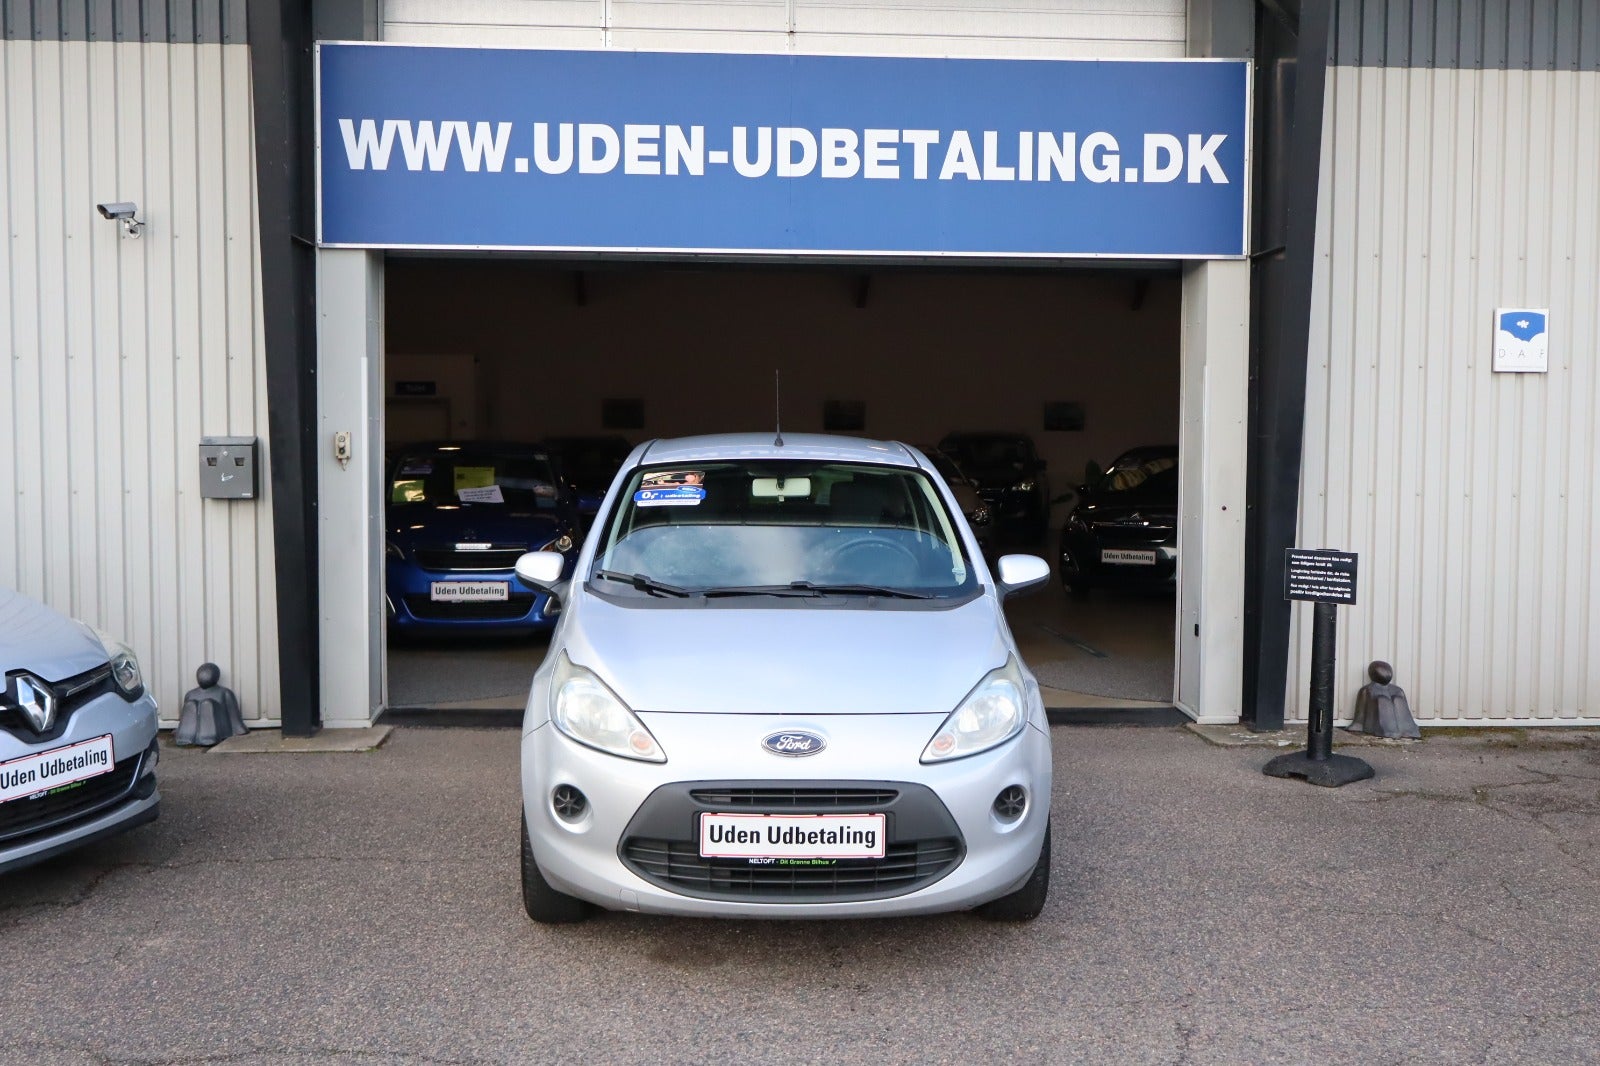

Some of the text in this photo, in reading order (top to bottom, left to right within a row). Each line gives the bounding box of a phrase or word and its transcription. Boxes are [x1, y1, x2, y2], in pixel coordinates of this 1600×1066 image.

[339, 118, 1229, 183] WWW.UDEN-UDBETALING.DK
[435, 587, 504, 597] Uden Udbetaling
[776, 735, 811, 750] Ford
[0, 769, 35, 789] Uden
[40, 750, 107, 779] Udbetaling
[709, 825, 876, 849] Uden Udbetaling
